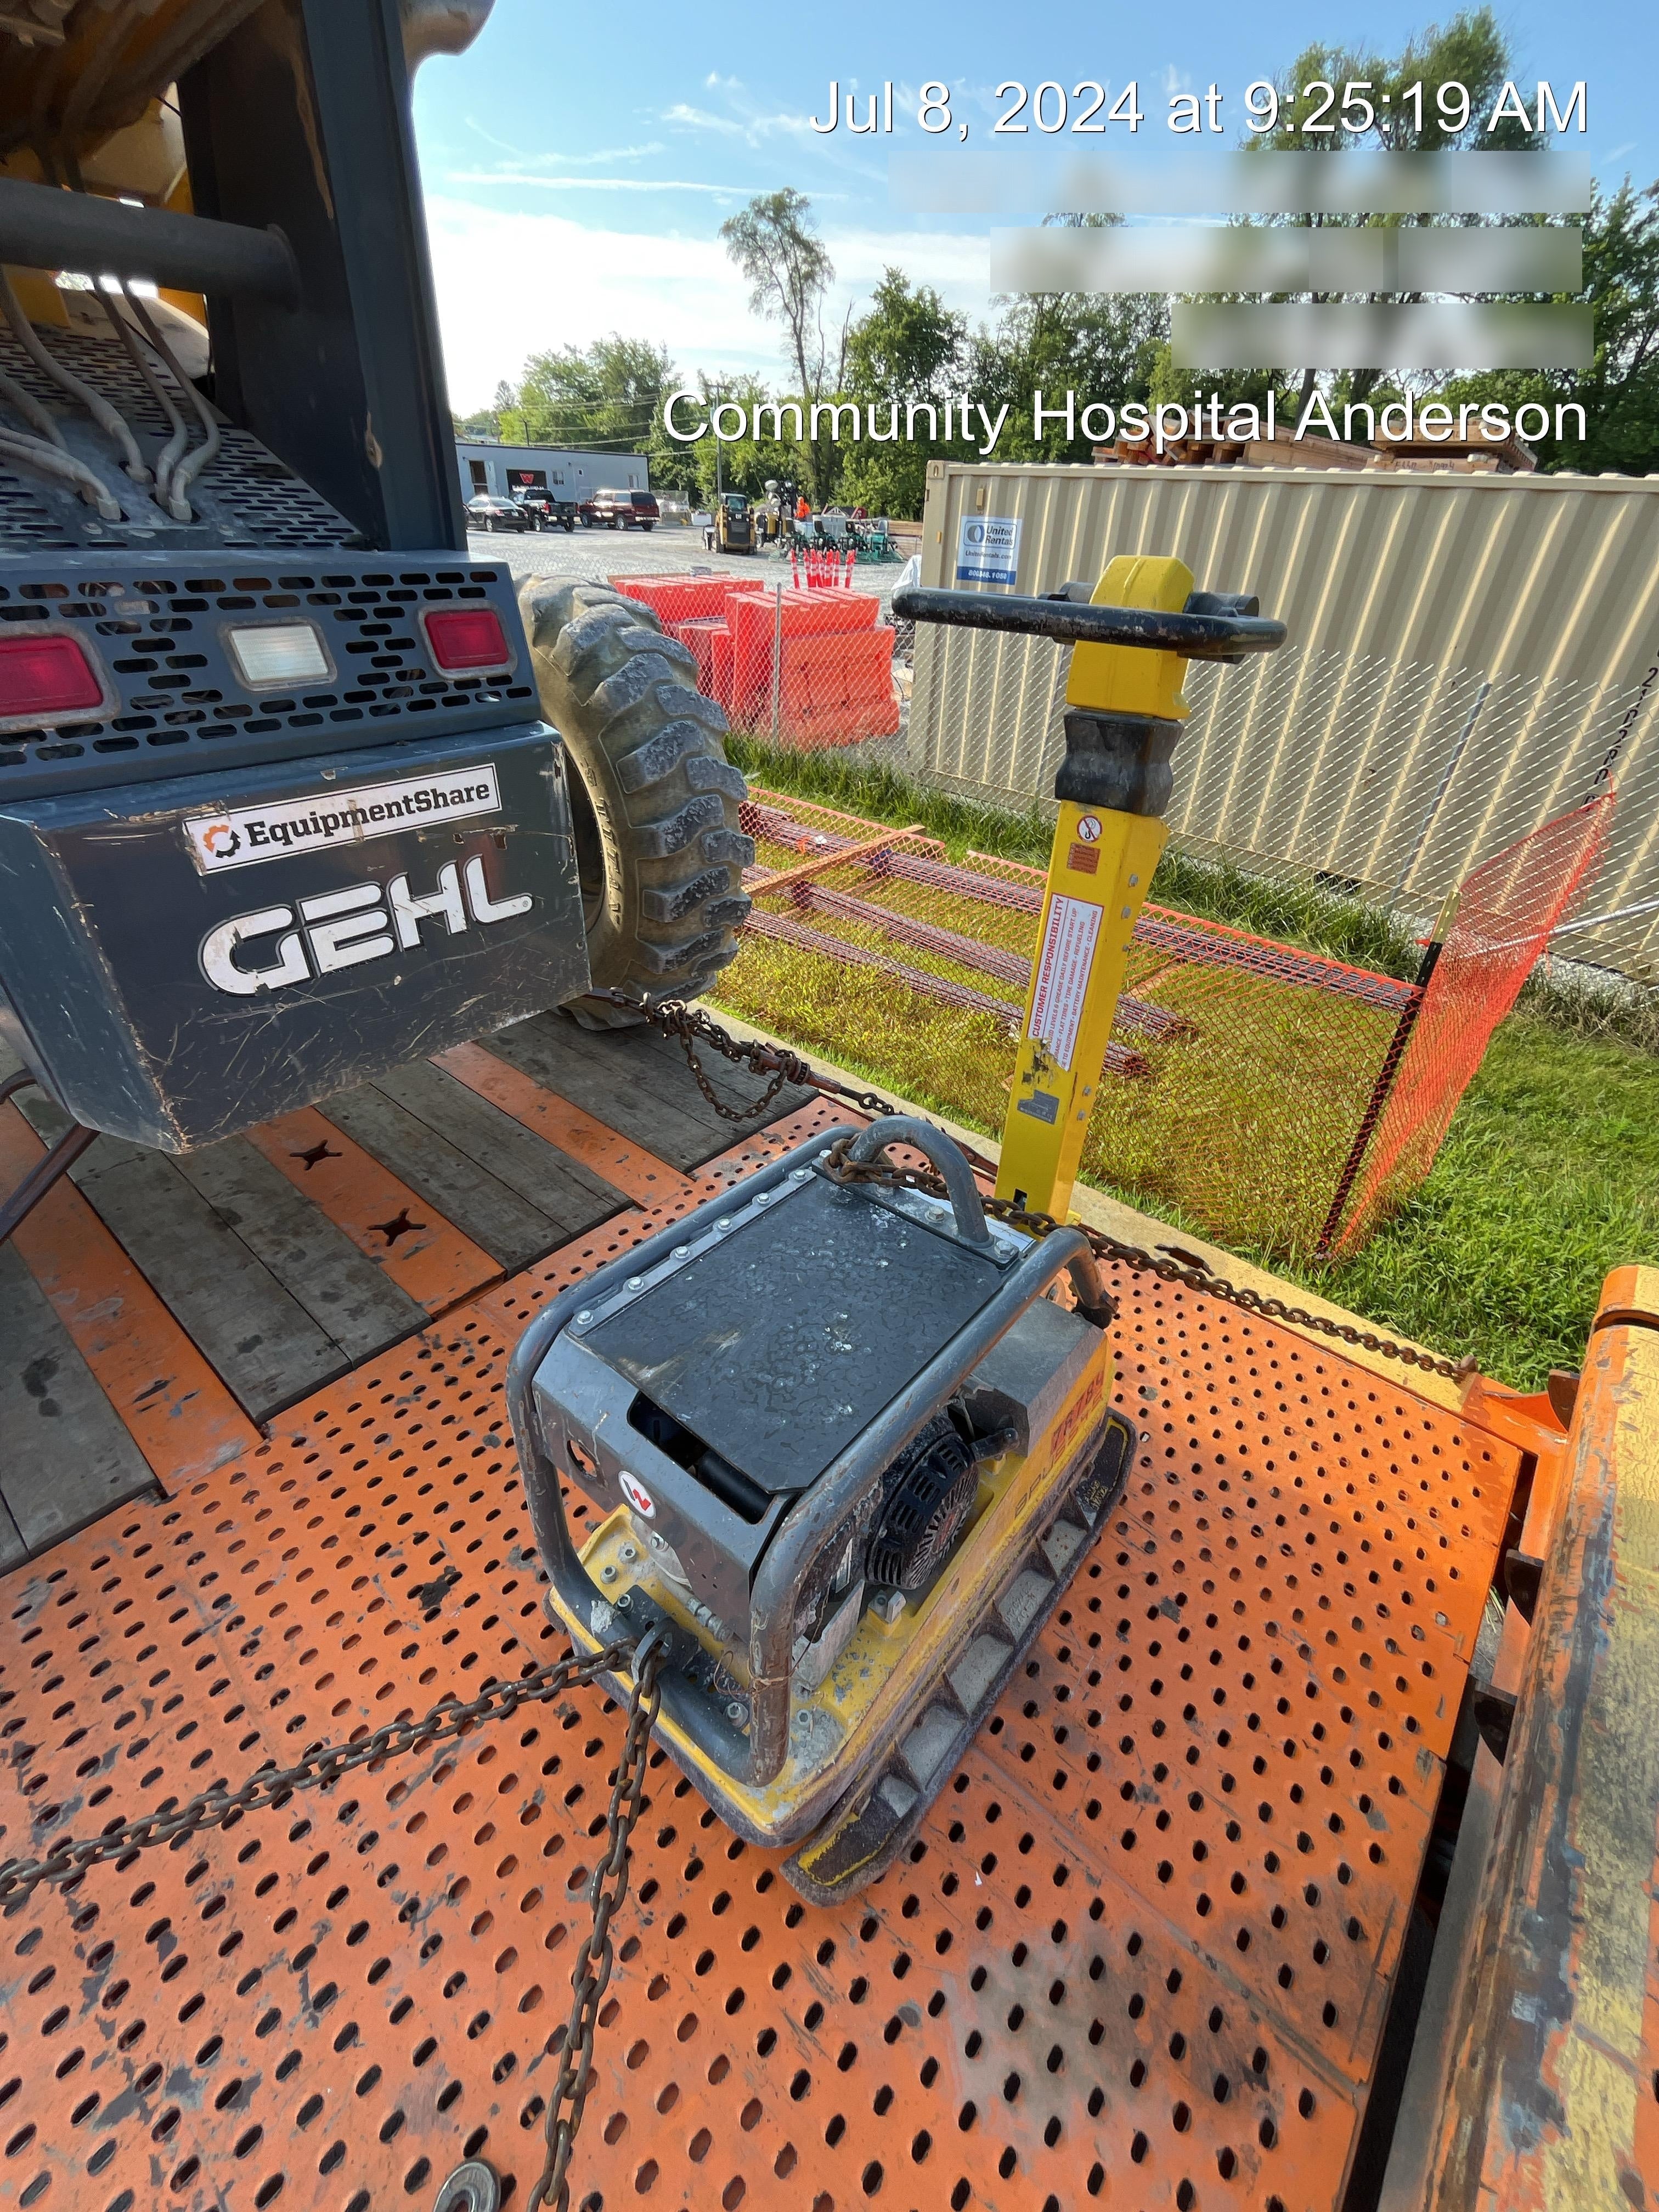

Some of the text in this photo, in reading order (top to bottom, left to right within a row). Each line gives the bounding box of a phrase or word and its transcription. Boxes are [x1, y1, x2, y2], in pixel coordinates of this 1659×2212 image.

[985, 535, 1013, 545] Rentals
[986, 525, 1013, 536] United
[244, 783, 490, 846] EquipmentShare
[198, 853, 534, 997] GEHL
[1075, 921, 1084, 955] REFUELING
[1032, 897, 1064, 1036] CUSTOMER RESPONSIBILITY
[1065, 1019, 1075, 1052] EQUIPMENT
[1078, 945, 1090, 990] MAINTENANCE
[1088, 910, 1097, 942] CLEANING
